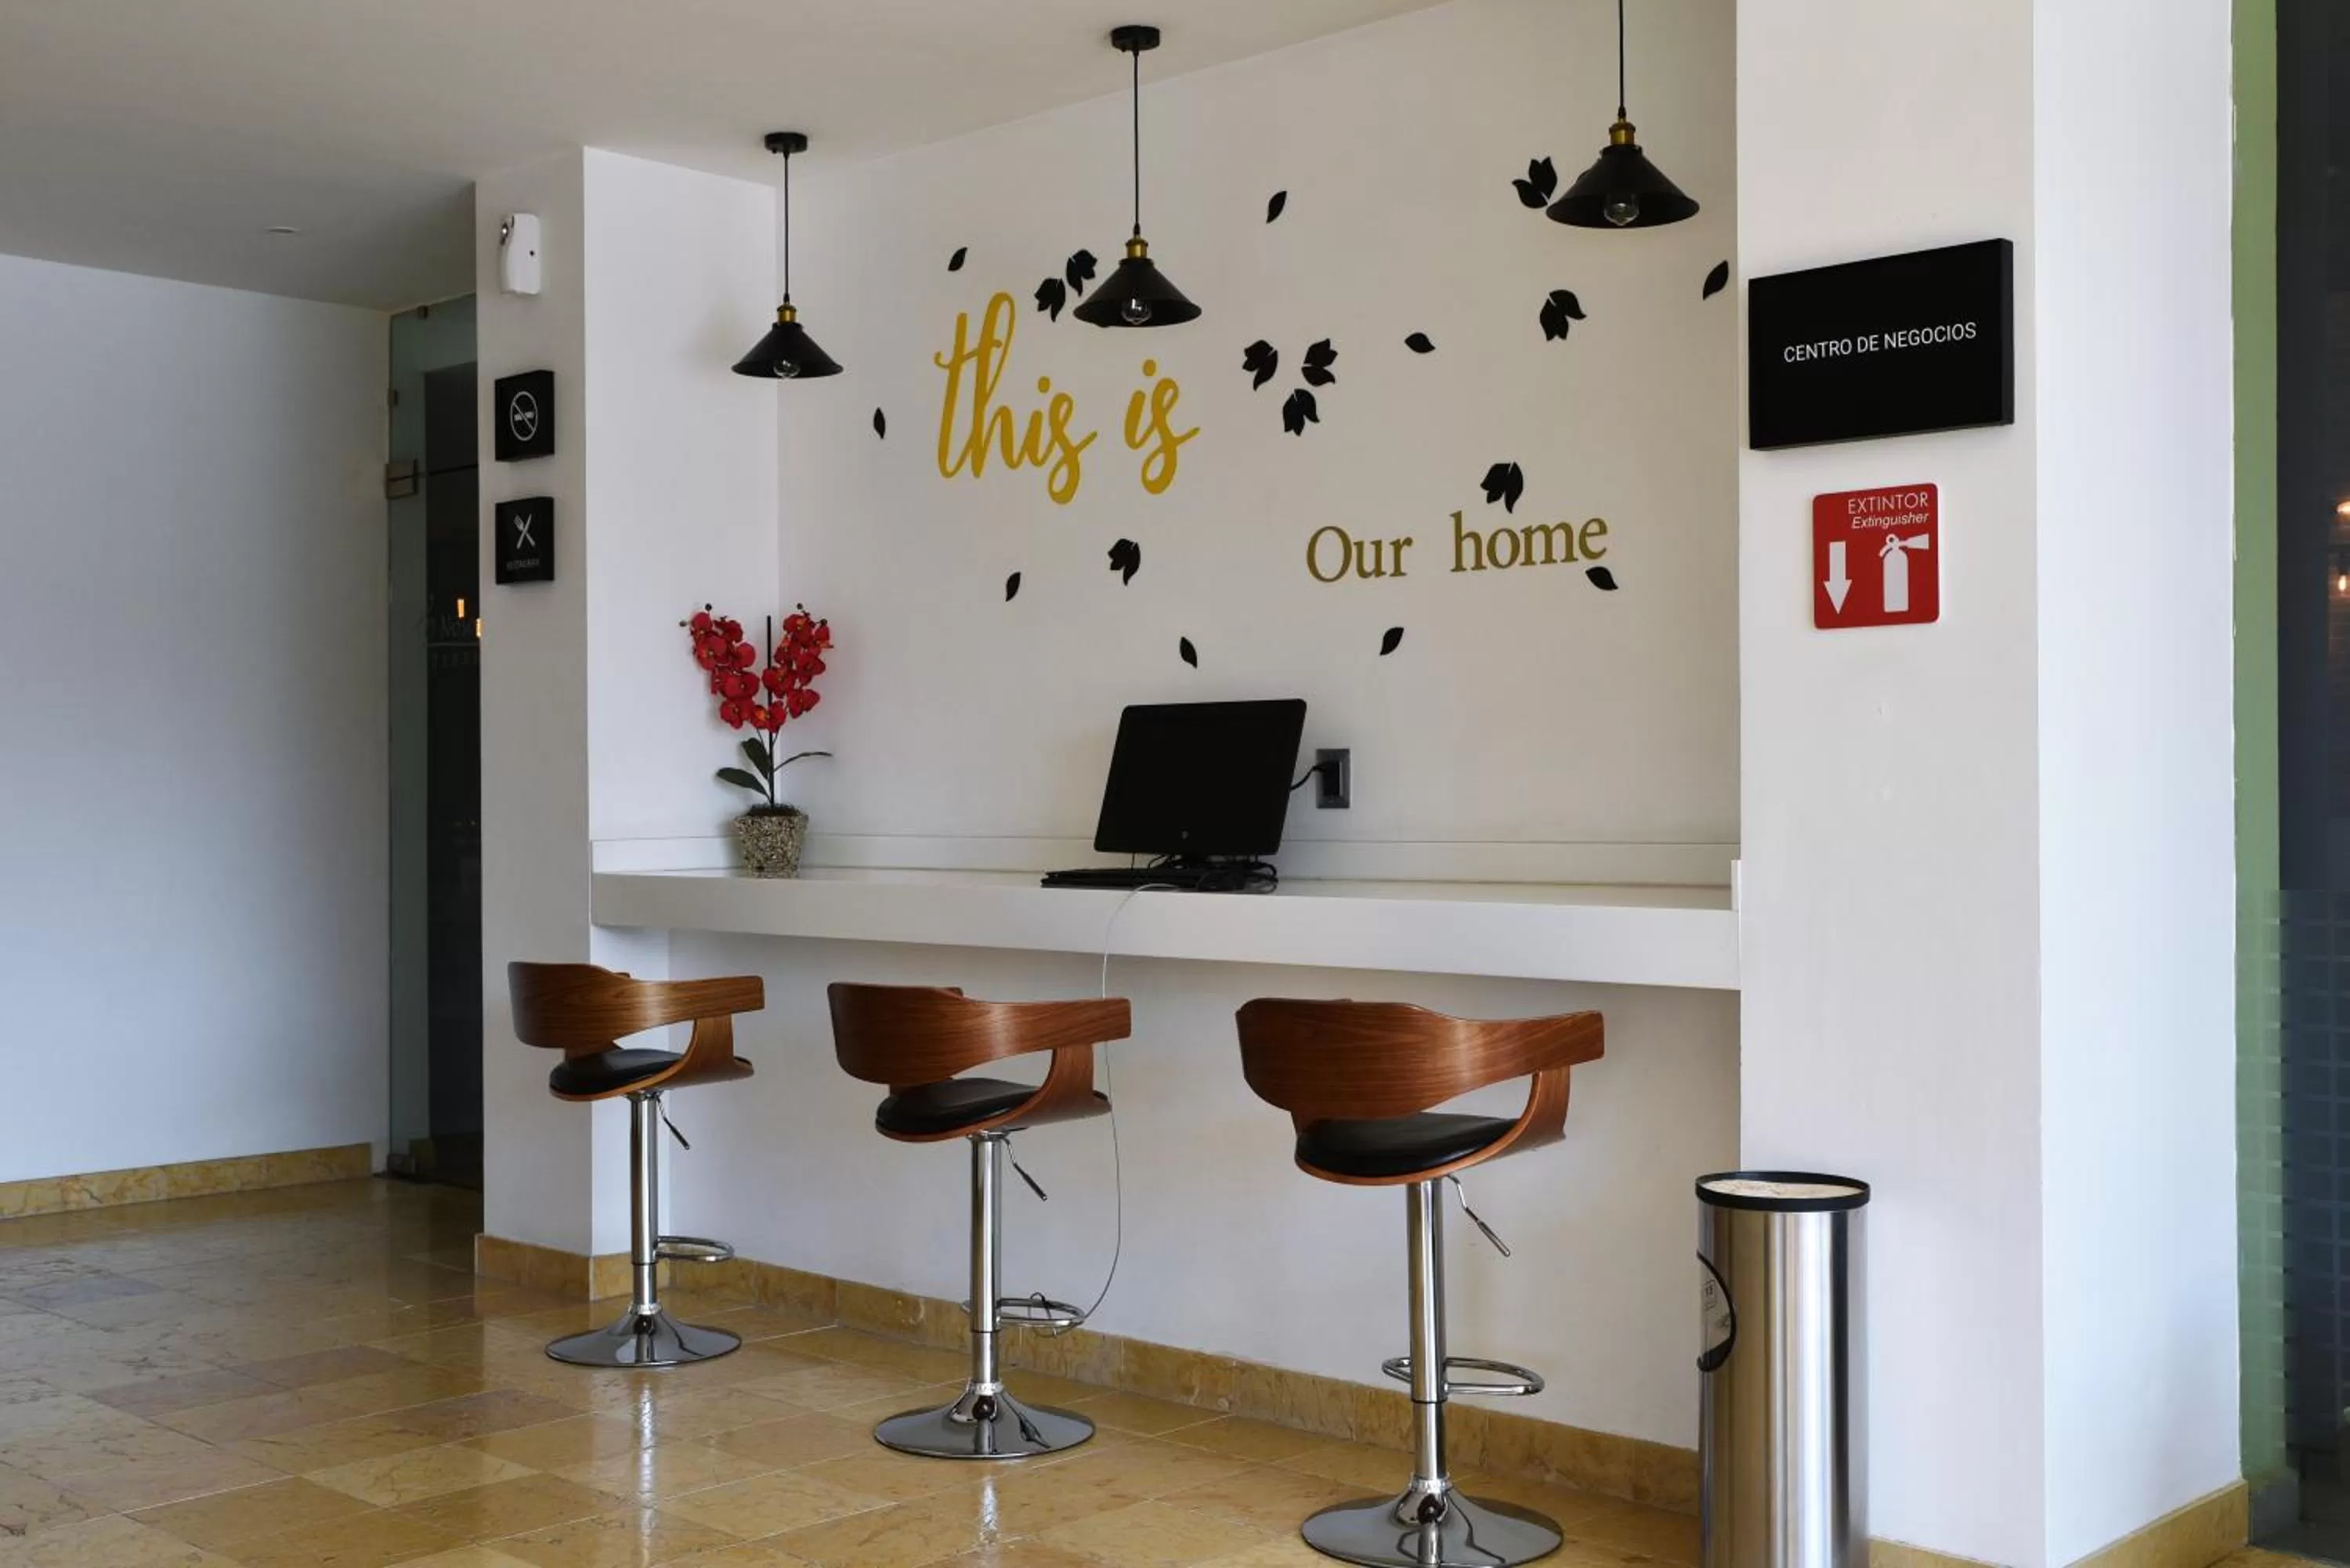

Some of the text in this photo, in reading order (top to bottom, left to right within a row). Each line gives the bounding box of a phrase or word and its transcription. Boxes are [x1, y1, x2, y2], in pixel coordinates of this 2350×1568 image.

[1784, 322, 1976, 363] CENTRO DE NEGOCIOS
[934, 291, 1200, 505] this is
[1848, 492, 1929, 515] EXTINTOR
[1851, 511, 1929, 529] Extinguisher
[1306, 511, 1608, 583] Our home
